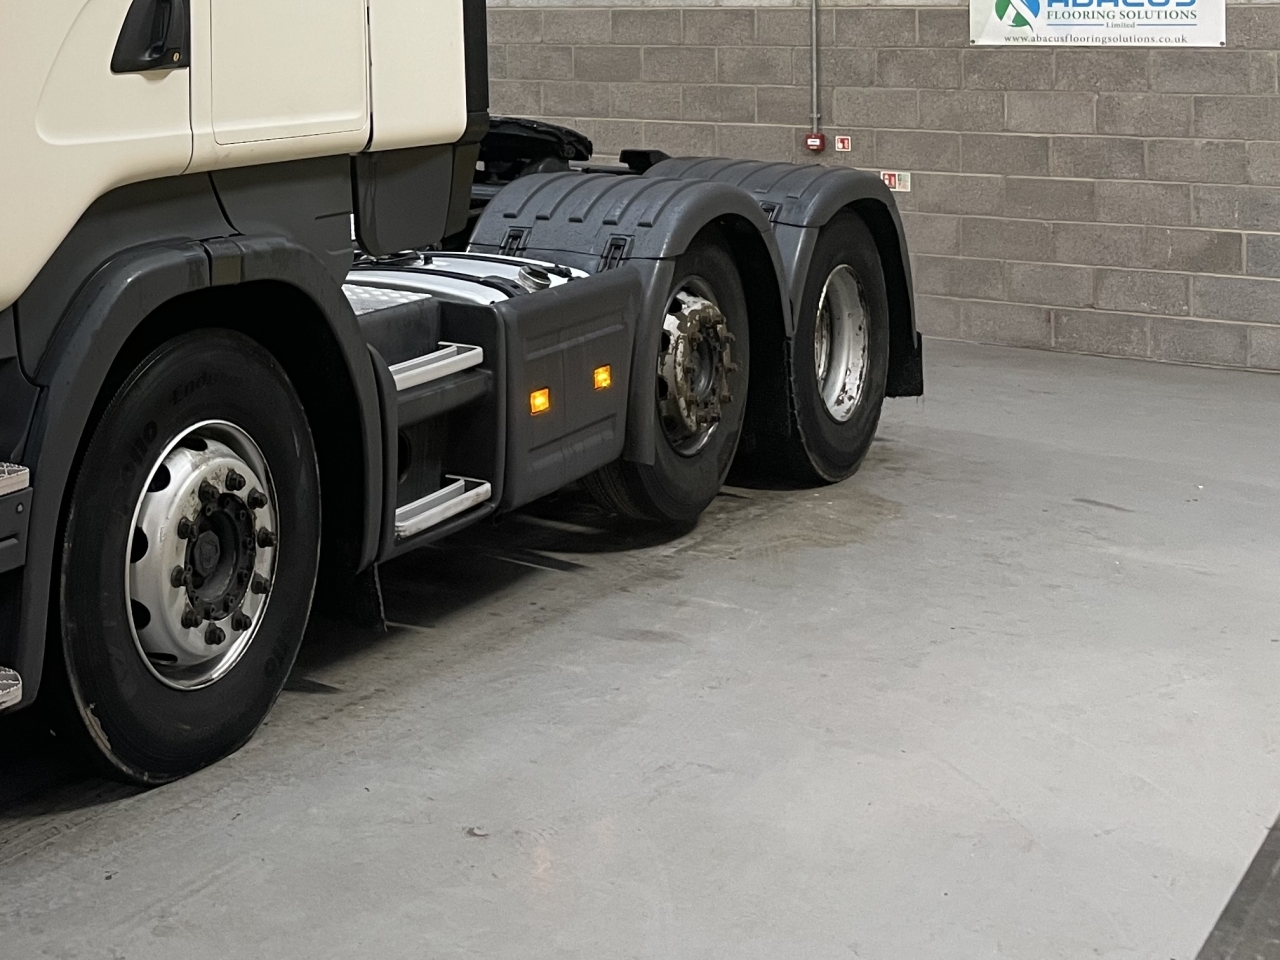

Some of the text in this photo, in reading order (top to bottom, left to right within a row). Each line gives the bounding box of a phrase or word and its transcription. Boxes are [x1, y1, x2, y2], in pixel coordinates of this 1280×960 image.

[1046, 9, 1198, 20] FLOORING SOLUTIONS
[1106, 21, 1136, 29] Limited
[1004, 33, 1189, 45] www.abacusflooringsolutions.co.uk
